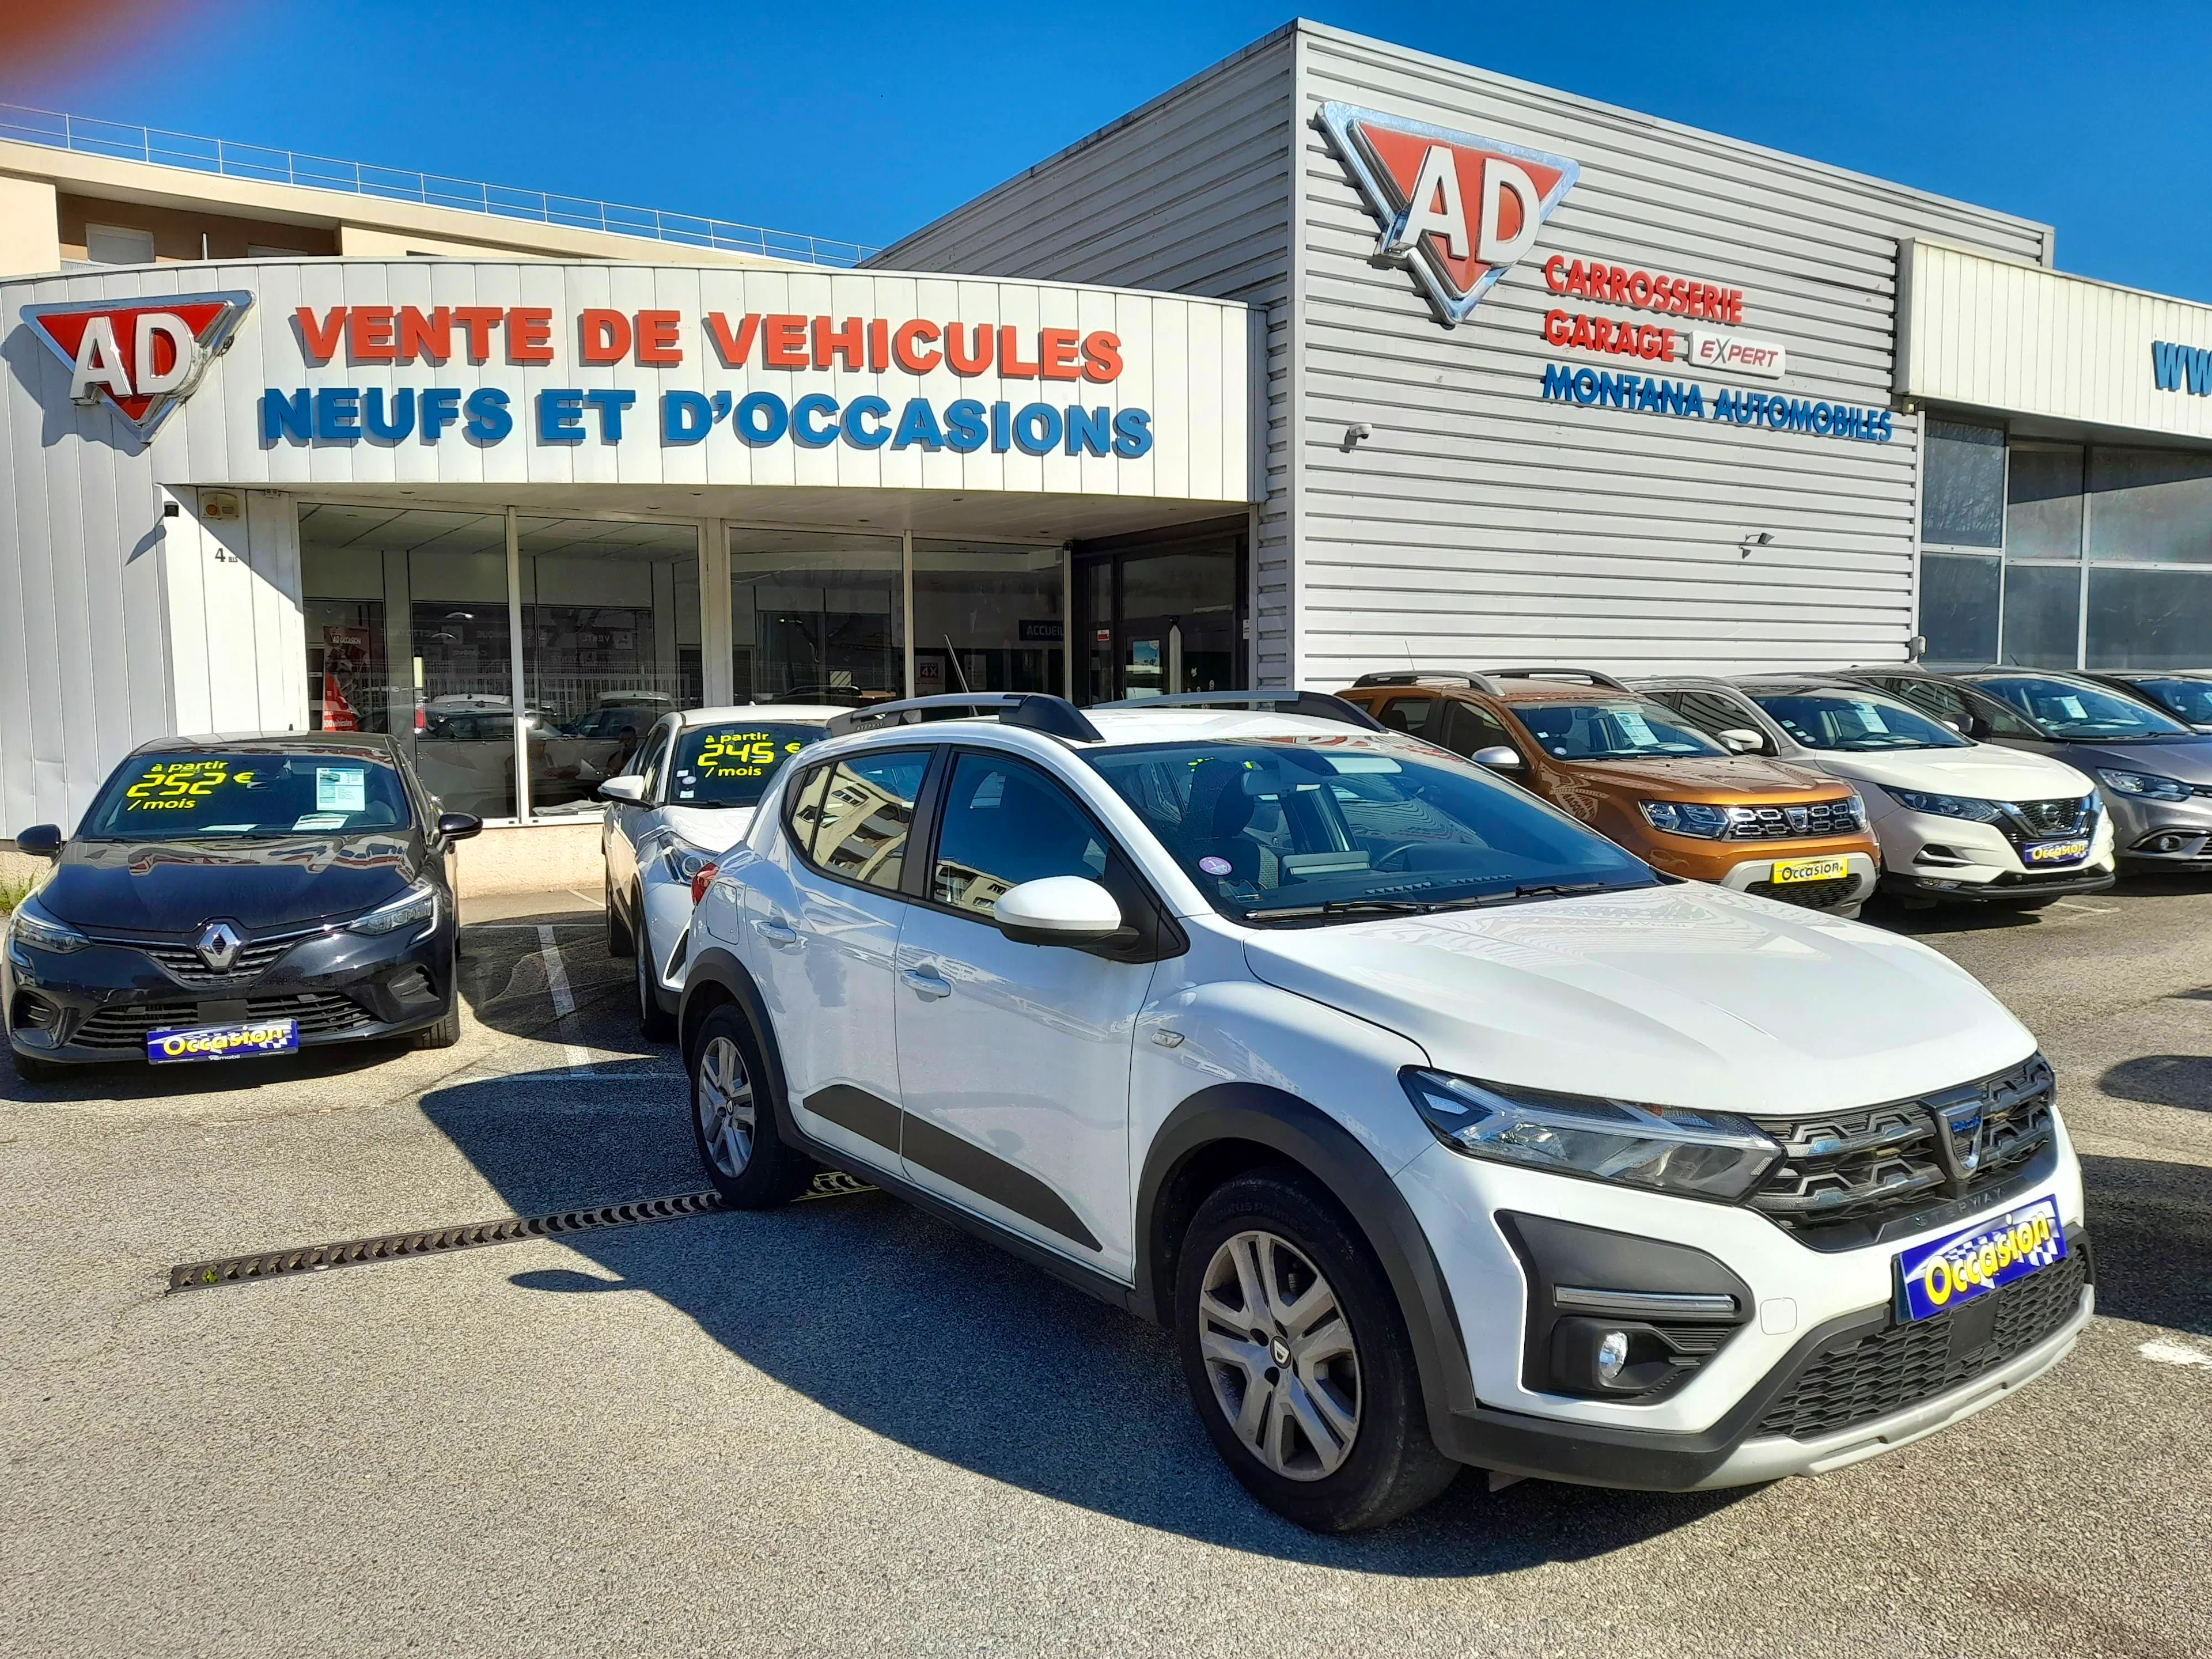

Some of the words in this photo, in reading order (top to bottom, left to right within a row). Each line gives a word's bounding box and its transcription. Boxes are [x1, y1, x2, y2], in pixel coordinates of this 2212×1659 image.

[1397, 144, 1541, 265] AD
[1544, 255, 1743, 324] CARROSSERIE
[296, 305, 555, 361] VENTE
[582, 308, 683, 362] DE
[709, 312, 1123, 381] VEHICULES
[1544, 309, 1676, 362] GARAGE
[70, 312, 198, 401] AD
[1543, 364, 1706, 418] MONTANA
[1714, 389, 1893, 442] AUTOMOBILES
[263, 387, 513, 442] NEUFS
[539, 389, 636, 441] ET
[664, 389, 1153, 457] D'OCCASIONS
[215, 547, 226, 562] 4
[1027, 626, 1063, 636] ACCUEIL
[705, 735, 715, 743] à
[720, 732, 770, 744] partir
[151, 763, 163, 772] à
[168, 760, 229, 772] partir
[697, 742, 775, 767] 245
[126, 772, 226, 798] 252
[718, 766, 762, 777] mois
[142, 797, 196, 810] mois
[2032, 841, 2085, 861] Occasion
[1781, 860, 1839, 881] Occasion
[163, 1025, 284, 1056] Occasion
[1914, 1185, 2005, 1228] STEPWAY
[1924, 1211, 2051, 1306] Occasion
